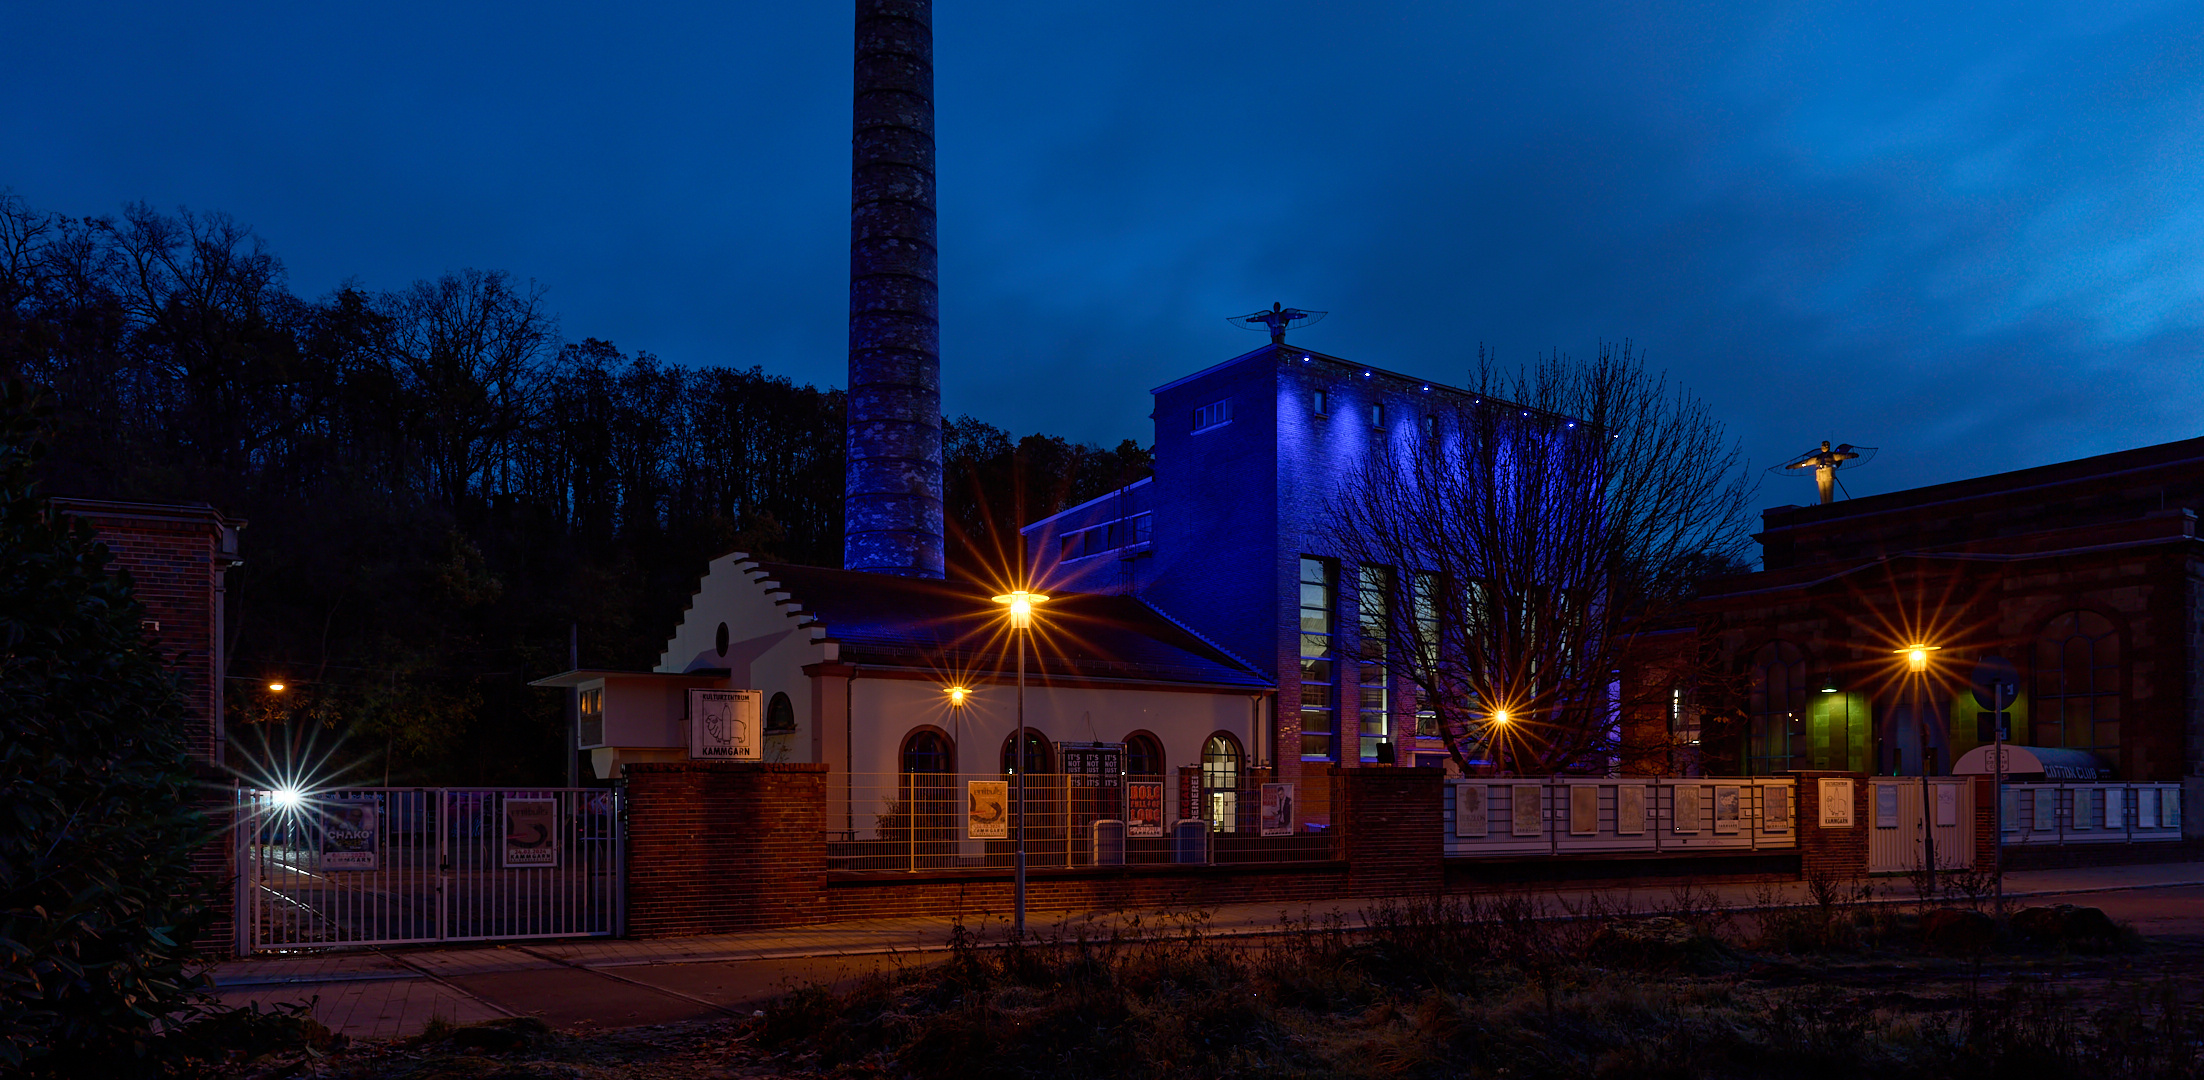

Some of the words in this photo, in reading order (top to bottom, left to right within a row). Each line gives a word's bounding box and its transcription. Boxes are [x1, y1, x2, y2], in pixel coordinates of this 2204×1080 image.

[702, 747, 750, 756] KAMMGARN
[1068, 753, 1081, 761] IT'S
[1105, 754, 1117, 762] IT'S
[2044, 765, 2077, 779] COTTON
[2076, 766, 2097, 780] CLUB
[1087, 779, 1100, 787] IT'S
[1105, 779, 1118, 787] IT'S
